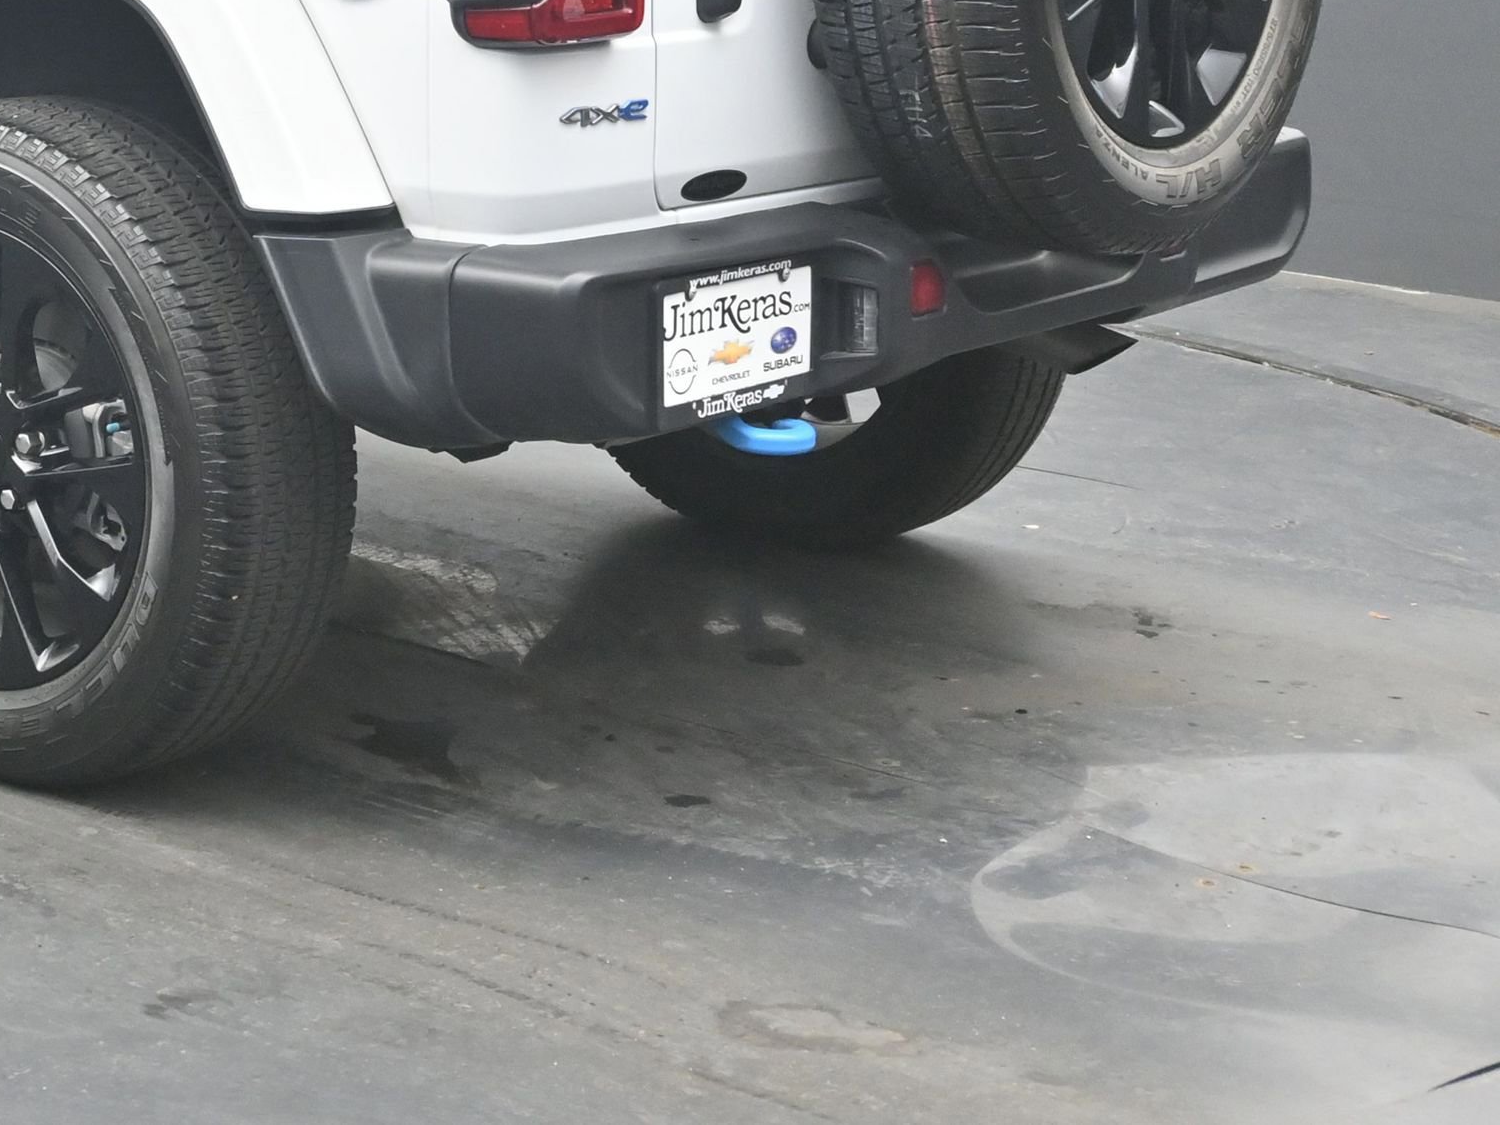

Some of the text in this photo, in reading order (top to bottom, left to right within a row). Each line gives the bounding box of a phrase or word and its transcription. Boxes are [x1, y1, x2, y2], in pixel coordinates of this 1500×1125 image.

[1094, 123, 1149, 181] ALENZA
[688, 259, 792, 290] www.jimkeras.com
[666, 364, 699, 378] NISSAN
[762, 355, 804, 372] SUBARU
[711, 370, 751, 386] CHEVROLET
